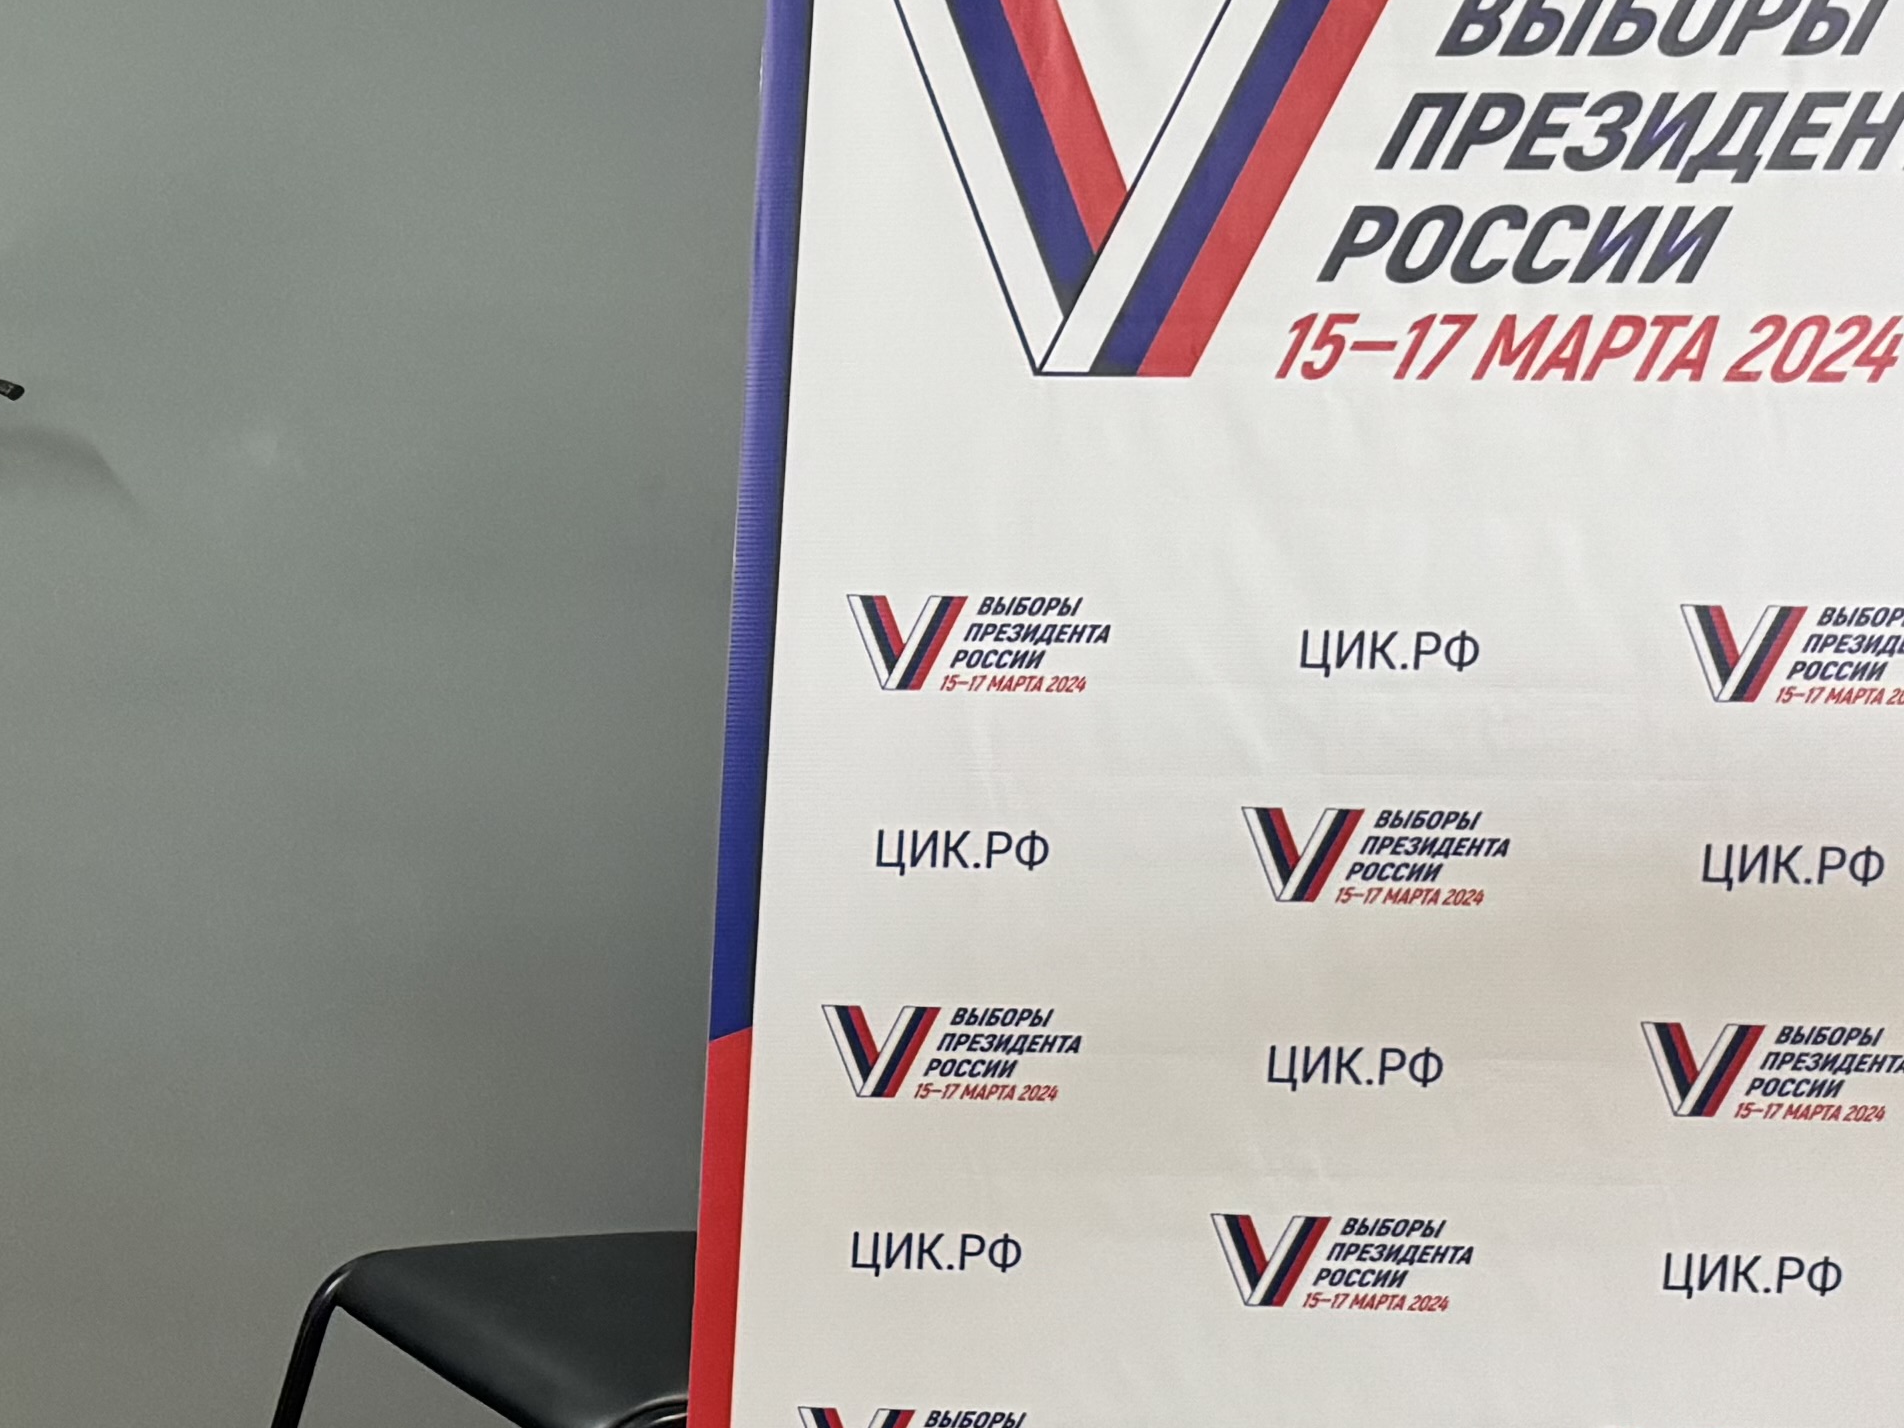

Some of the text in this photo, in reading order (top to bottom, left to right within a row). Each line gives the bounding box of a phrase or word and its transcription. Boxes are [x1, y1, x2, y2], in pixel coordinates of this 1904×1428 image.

[1375, 91, 1904, 183] ПРЕЗИДЕН
[1317, 204, 1733, 284] РОССИИ
[1471, 314, 1720, 382] МАРТА
[1723, 314, 1903, 383] 2024
[977, 596, 1083, 616] ВЫБОРЫ
[1817, 606, 1904, 627] ВЫБОР
[963, 623, 1111, 646] ПРЕЗИДЕНТА
[950, 649, 1046, 669] РОССИИ
[1300, 629, 1479, 678] ЦИК.РФ
[1786, 661, 1888, 681] РОССИИ
[986, 675, 1044, 692] МАРТА
[1045, 676, 1086, 693] 2024
[1824, 687, 1885, 705] МАРТА
[1374, 810, 1483, 830] ВЫБОРЫ
[876, 829, 1049, 876] ЦИК.РФ
[1359, 836, 1510, 859] ПРЕЗИДЕНТА
[1345, 862, 1444, 882] РОССИИ
[1702, 844, 1884, 892] ЦИК.РФ
[1382, 888, 1441, 905] МАРТА
[1442, 889, 1484, 906] 2024
[950, 1007, 1054, 1027] ВЫБОРЫ
[936, 1033, 1082, 1055] ПРЕЗИДЕНТА
[1774, 1026, 1885, 1047] ВЫБОРЫ
[923, 1058, 1018, 1078] РОССИИ
[1268, 1045, 1443, 1092] ЦИК.РФ
[960, 1084, 1017, 1100] МАРТА
[1017, 1085, 1058, 1101] 2024
[1744, 1077, 1845, 1098] РОССИИ
[1782, 1104, 1842, 1121] МАРТА
[1843, 1105, 1885, 1122] 2024
[1340, 1217, 1447, 1238] ВЫБОРЫ
[851, 1231, 1021, 1277] ЦИК.РФ
[1326, 1242, 1474, 1266] ПРЕЗИДЕНТА
[1312, 1268, 1409, 1288] РОССИИ
[1663, 1252, 1842, 1299] ЦИК.РФ
[1349, 1293, 1407, 1310] МАРТА
[1407, 1295, 1449, 1312] 2024
